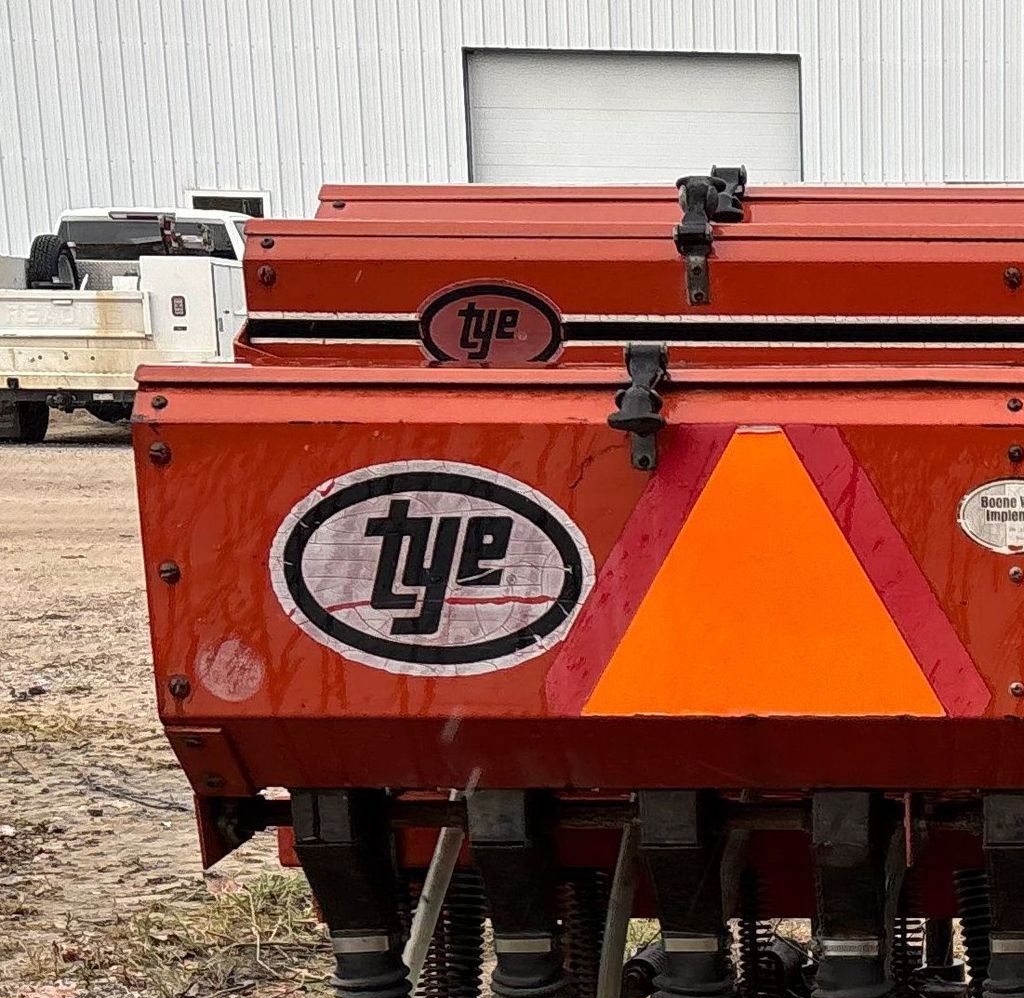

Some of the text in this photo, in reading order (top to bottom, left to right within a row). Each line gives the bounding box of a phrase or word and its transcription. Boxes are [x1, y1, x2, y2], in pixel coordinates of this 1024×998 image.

[457, 302, 519, 360] tye
[981, 496, 1016, 508] Boone
[365, 499, 513, 635] tye
